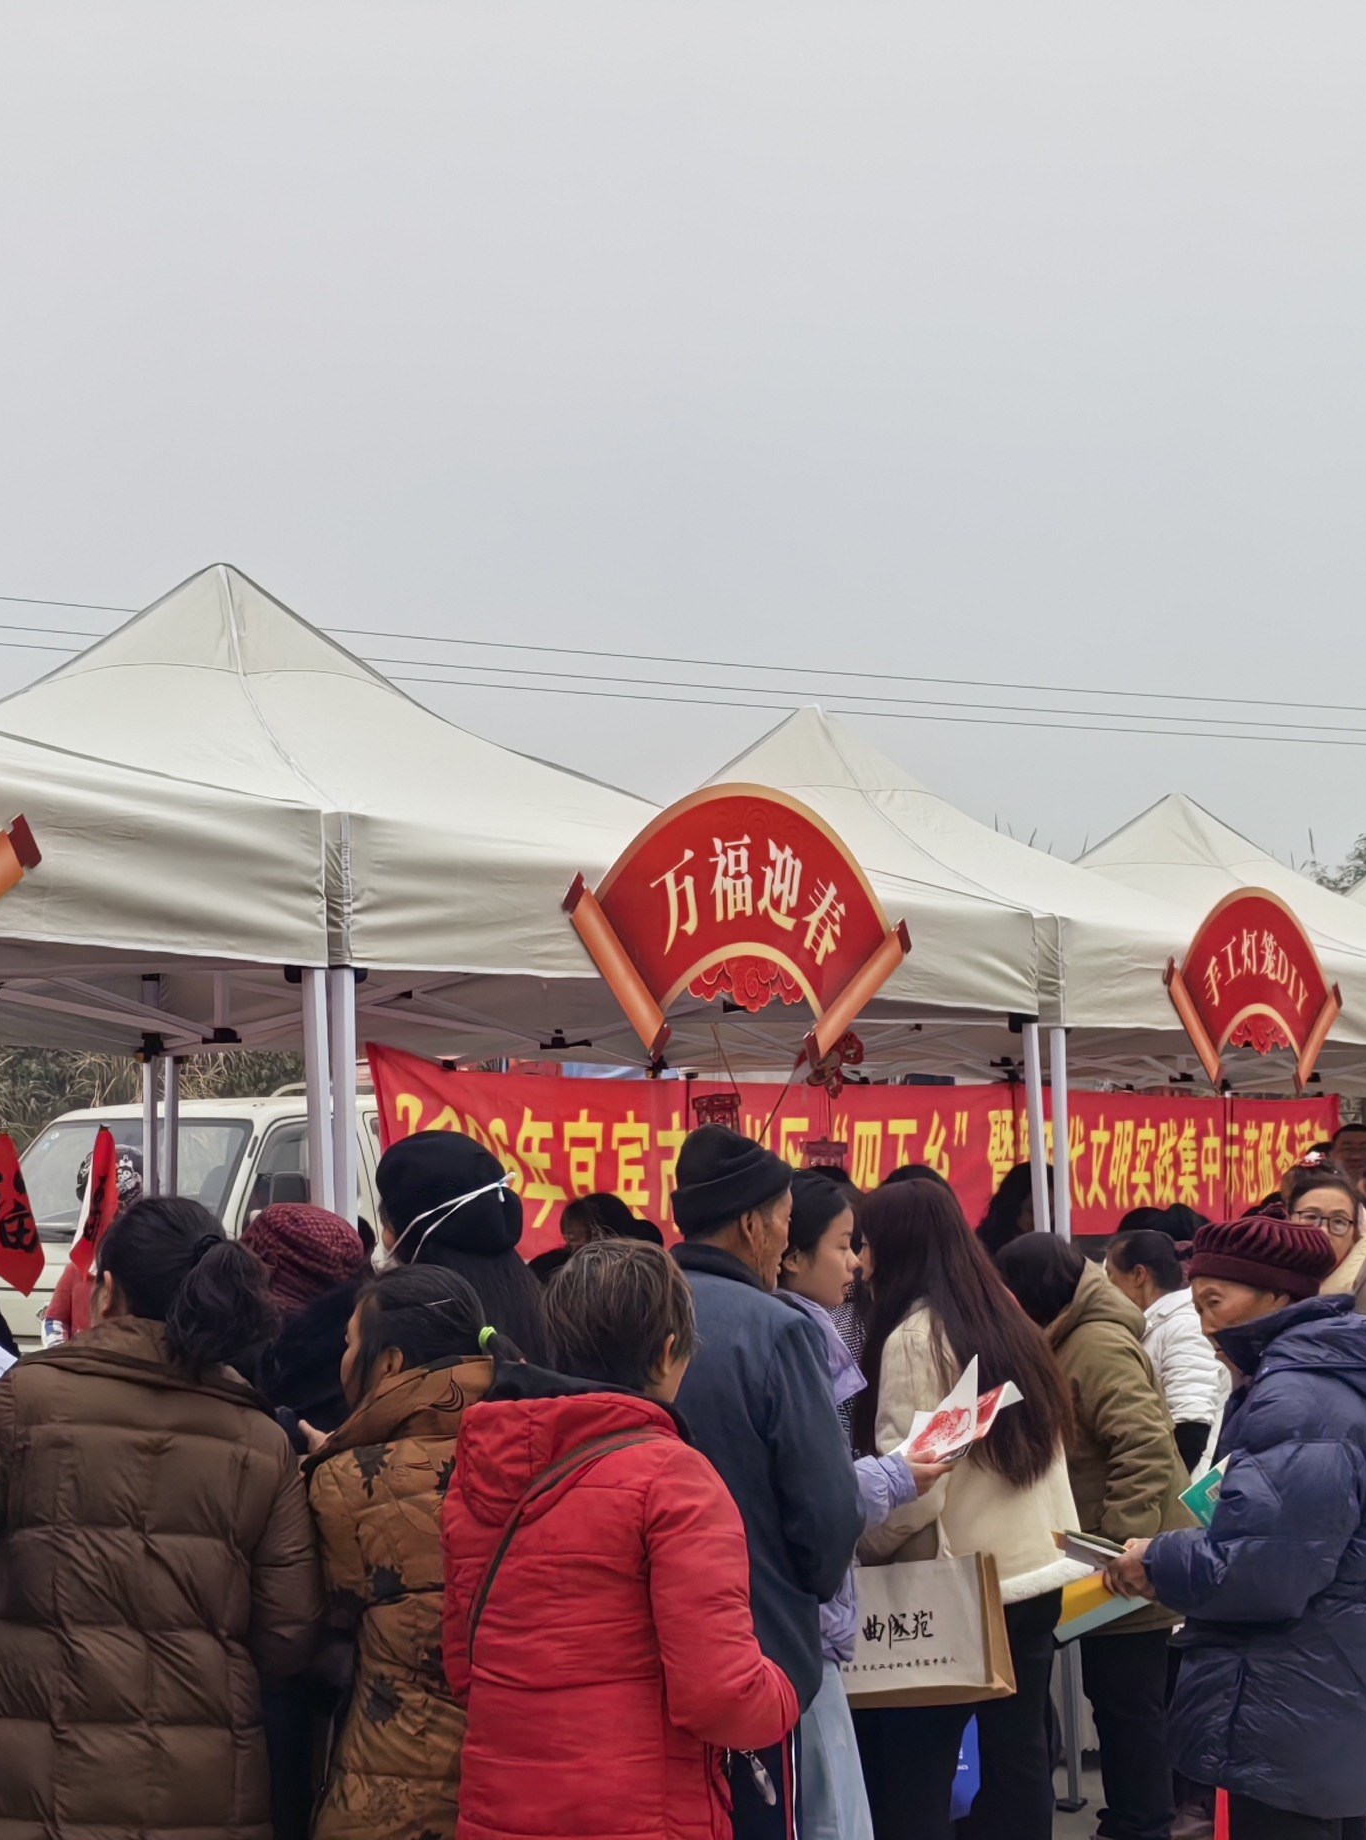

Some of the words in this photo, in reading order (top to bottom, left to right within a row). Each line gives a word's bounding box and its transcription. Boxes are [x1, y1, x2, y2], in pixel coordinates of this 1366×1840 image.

[649, 833, 847, 966] 万福迎春
[1203, 928, 1309, 1016] 手工灯笼DIY
